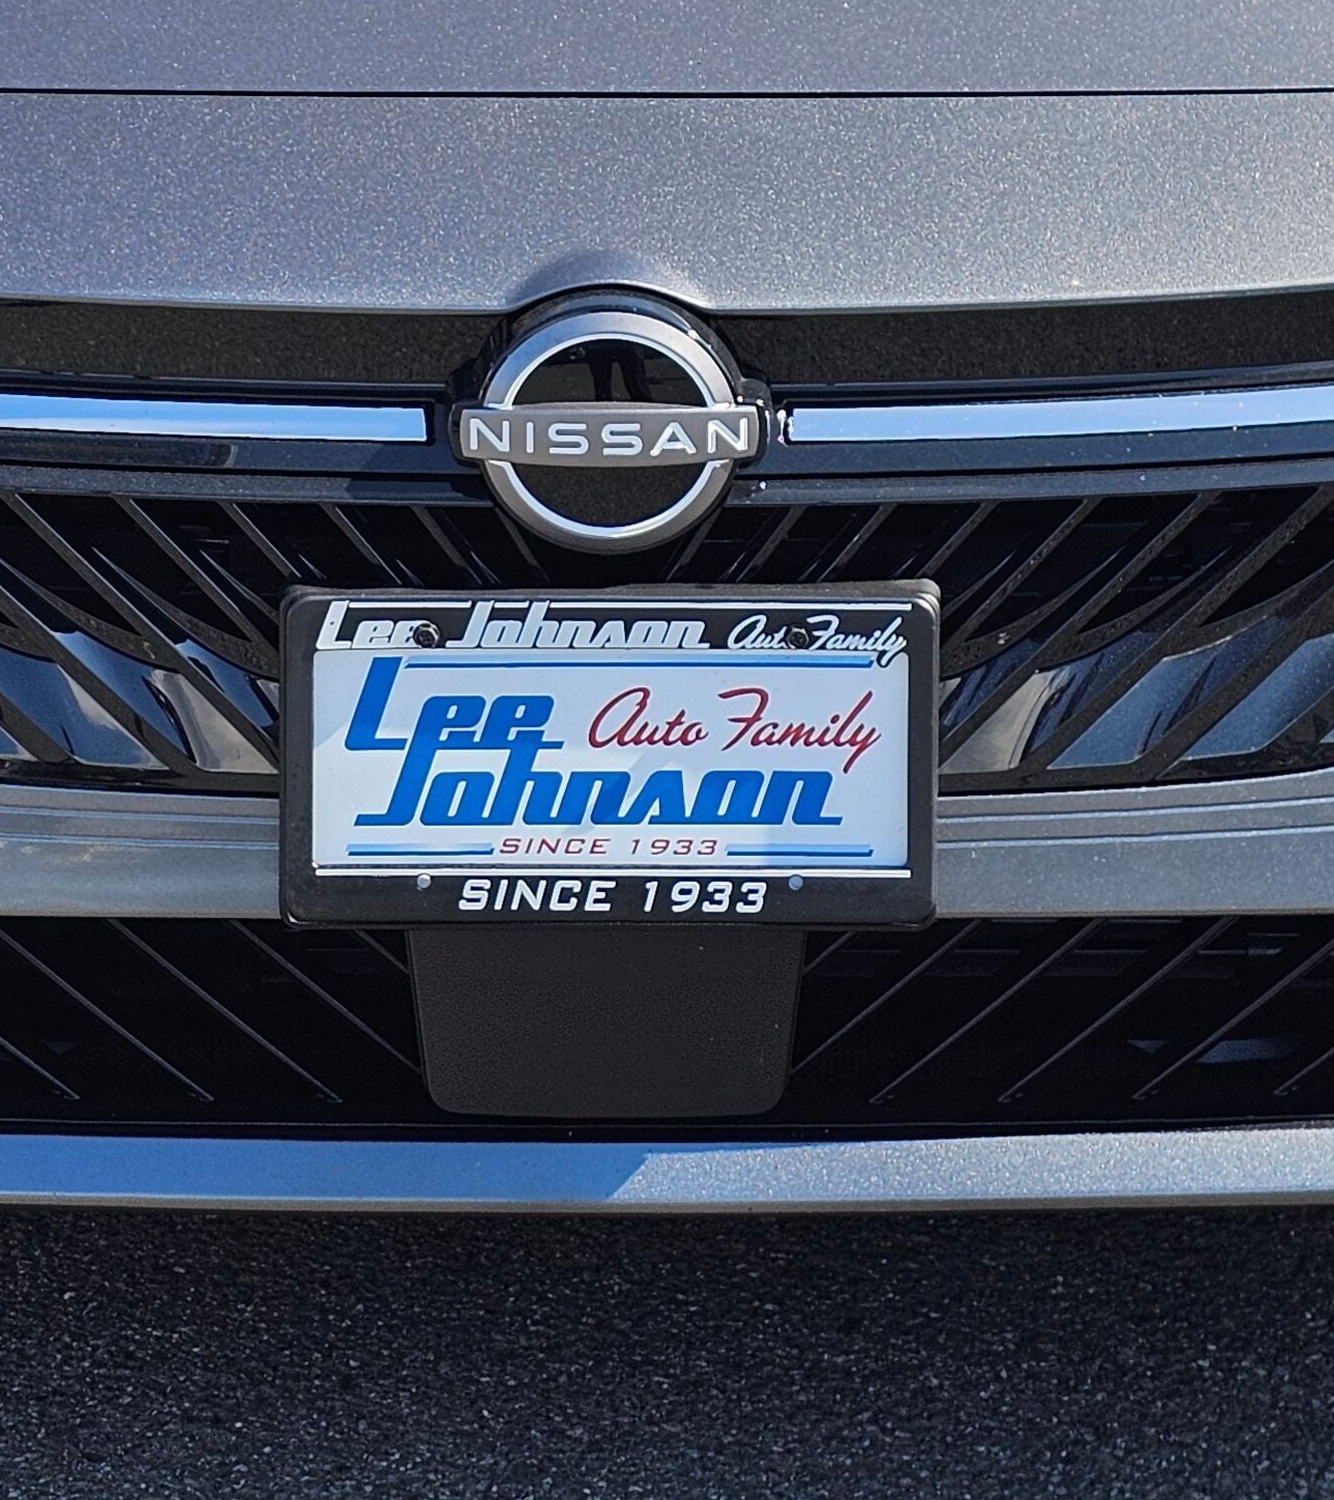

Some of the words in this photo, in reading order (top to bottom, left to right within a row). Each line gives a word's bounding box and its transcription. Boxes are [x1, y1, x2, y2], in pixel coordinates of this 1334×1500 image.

[467, 418, 751, 456] NISSAN
[445, 600, 710, 650] Johnson
[726, 614, 807, 650] Aut
[806, 615, 908, 667] Family
[343, 656, 565, 751] Lee
[587, 686, 709, 749] Auto
[718, 688, 882, 774] Family
[353, 742, 843, 826] Johnson
[499, 838, 611, 855] SINCE
[630, 838, 717, 856] 1933
[457, 880, 616, 913] SINCE
[642, 881, 767, 913] 1933
